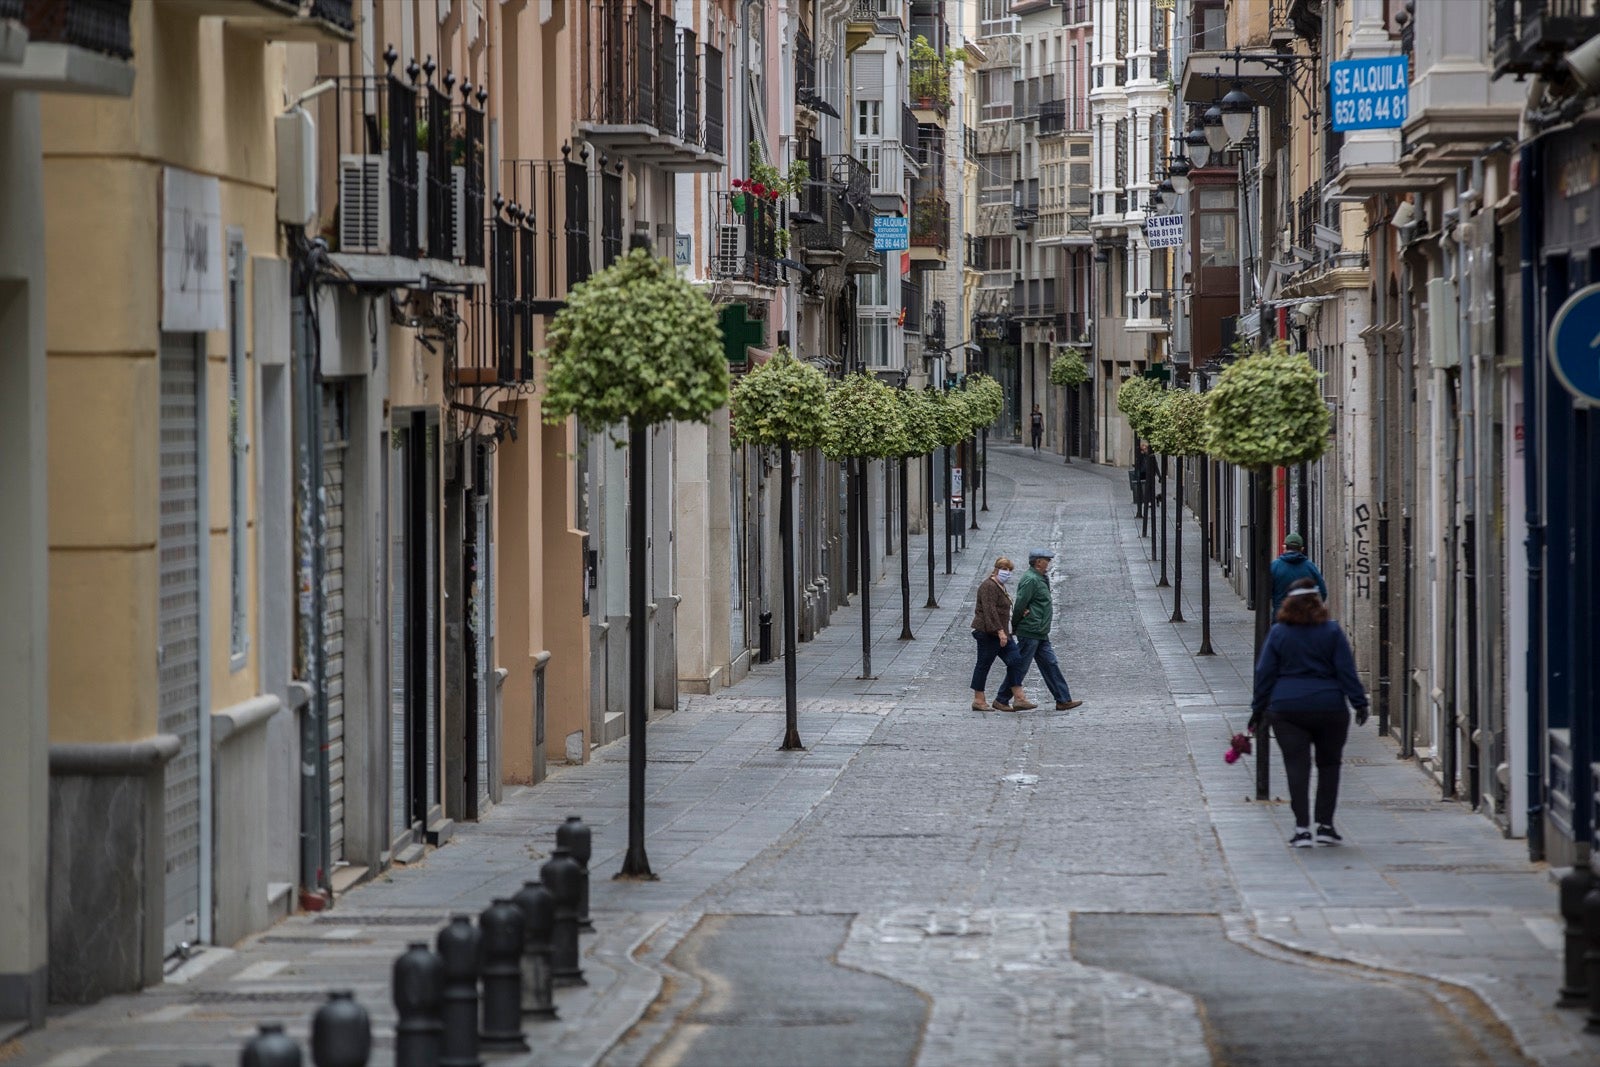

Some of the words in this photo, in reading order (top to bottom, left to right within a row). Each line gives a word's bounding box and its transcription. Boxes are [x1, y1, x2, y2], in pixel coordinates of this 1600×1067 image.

[1335, 69, 1351, 95] SE
[1352, 64, 1405, 93] ALQUILA
[1335, 100, 1356, 124] 652
[1358, 98, 1373, 122] 86
[1374, 96, 1390, 120] 44
[1392, 94, 1407, 119] 81
[874, 218, 883, 227] SE
[883, 218, 906, 227] ALQUILA
[1148, 218, 1158, 228] SE
[1149, 229, 1161, 238] 648
[1161, 229, 1169, 237] 81
[1169, 228, 1177, 236] 91
[893, 239, 901, 248] 44
[1169, 237, 1178, 246] 53
